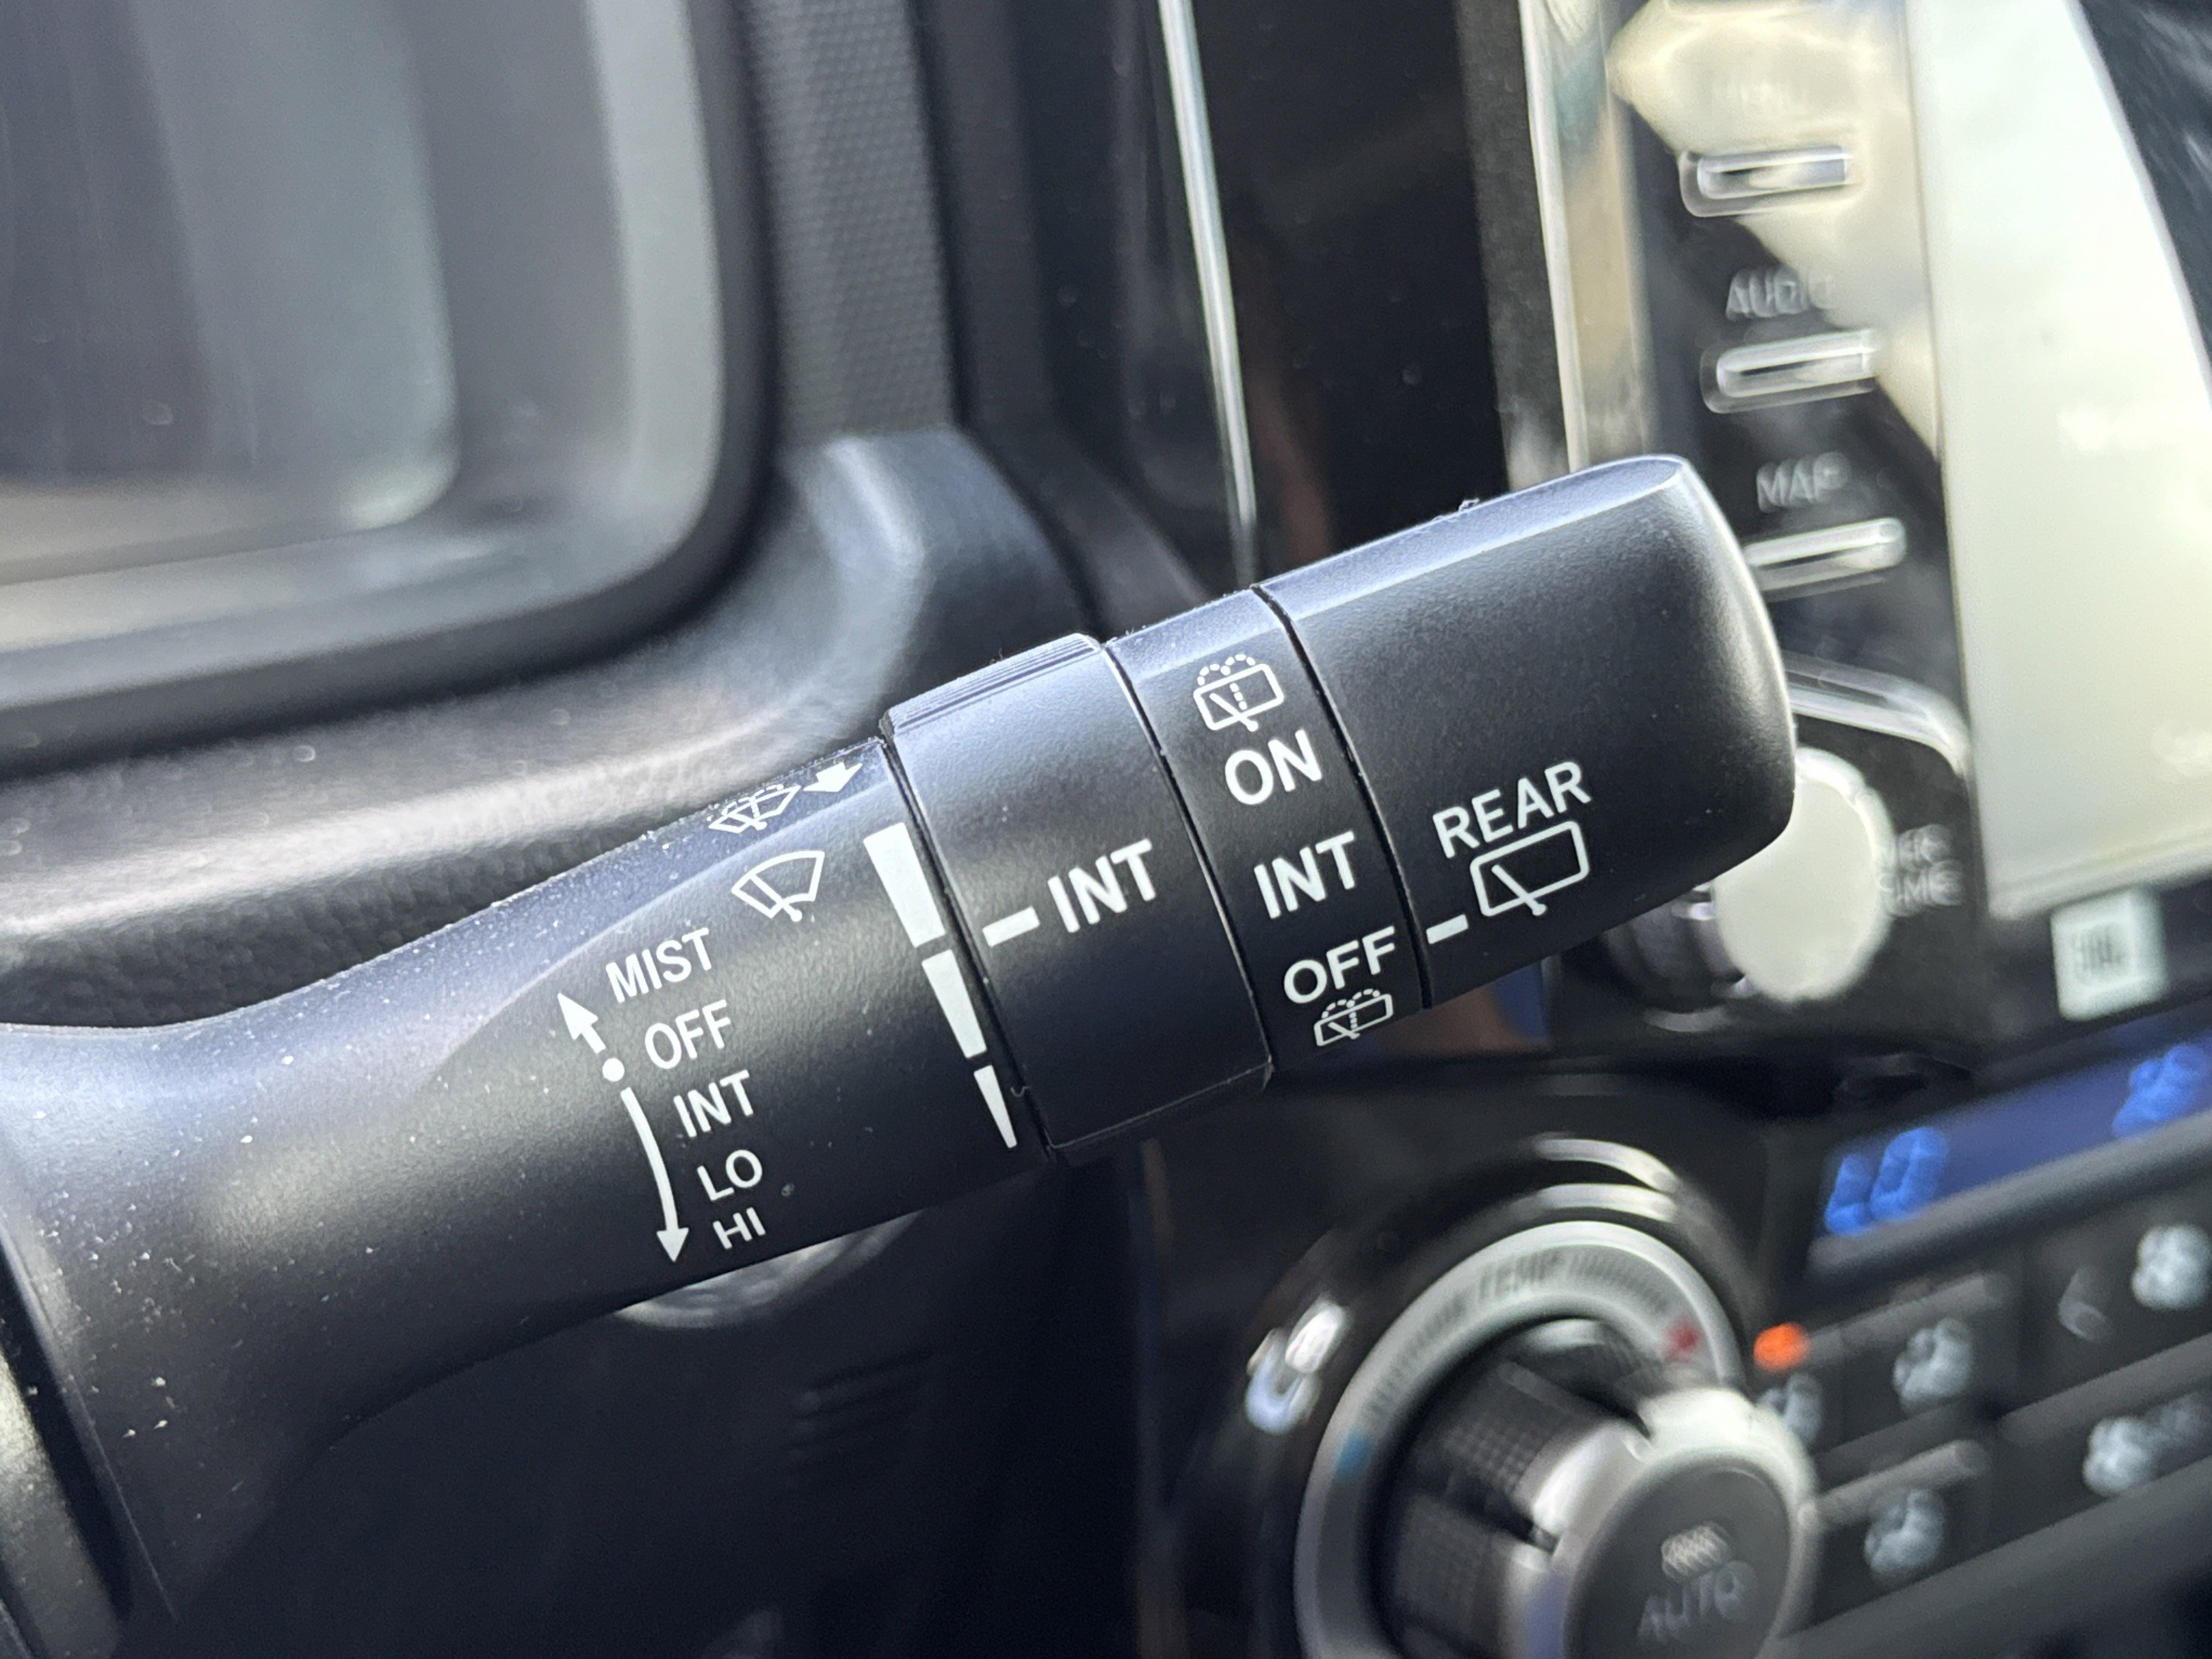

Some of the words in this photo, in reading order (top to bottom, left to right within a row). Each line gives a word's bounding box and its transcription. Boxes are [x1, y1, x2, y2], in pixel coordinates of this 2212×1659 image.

[1224, 727, 1323, 806] ON
[1432, 761, 1592, 858] REAR
[1046, 838, 1156, 933] INT
[1253, 830, 1356, 919] INT
[605, 927, 710, 1003] MIST
[1284, 926, 1396, 1003] OFF
[644, 999, 732, 1069] OFF
[673, 1069, 754, 1138] INT
[697, 1149, 763, 1201] LO
[713, 1207, 766, 1249] HI
